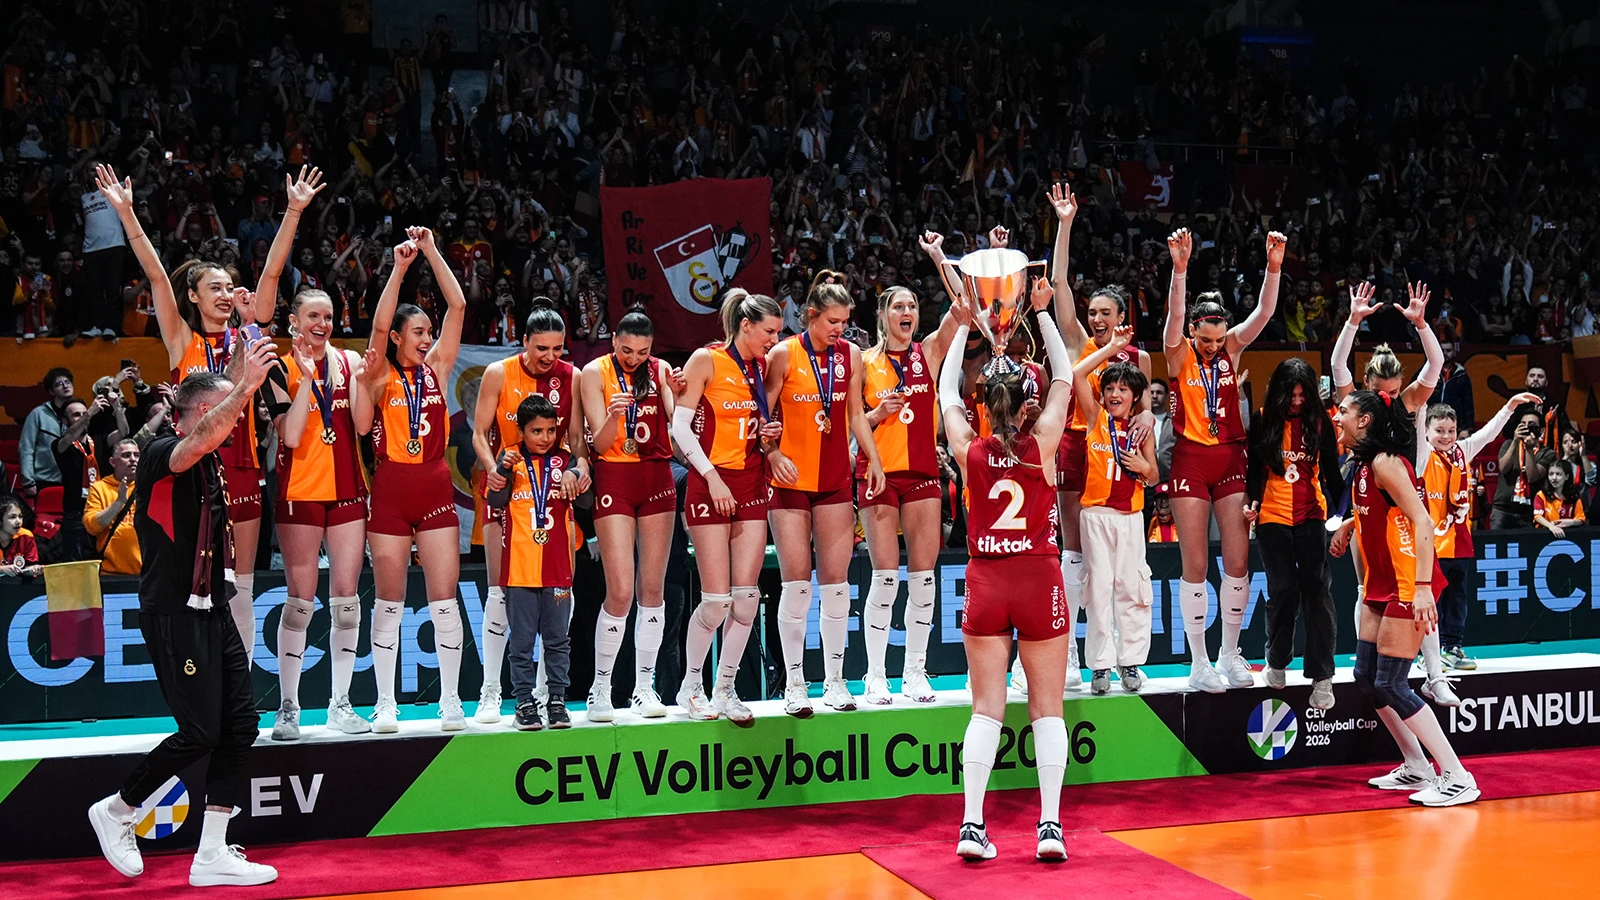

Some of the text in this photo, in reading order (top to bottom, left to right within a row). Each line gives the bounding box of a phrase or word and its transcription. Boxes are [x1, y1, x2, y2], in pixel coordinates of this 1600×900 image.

[626, 236, 643, 255] Ri
[626, 262, 647, 281] Ve
[814, 409, 830, 432] 9
[899, 401, 915, 425] 6
[624, 421, 651, 443] 0
[738, 417, 759, 440] 12
[1285, 463, 1300, 484] 8
[767, 487, 775, 502] 9
[1173, 479, 1190, 493] 14
[287, 500, 294, 516] 1
[690, 503, 710, 518] 12
[988, 478, 1027, 530] 2
[529, 506, 555, 531] 13
[977, 535, 1033, 553] tiktak
[1305, 707, 1327, 719] CEV
[1305, 718, 1378, 734] Volleyball Cup
[1305, 734, 1331, 747] 2026
[515, 721, 1094, 806] CEV Volleyball Cup 206
